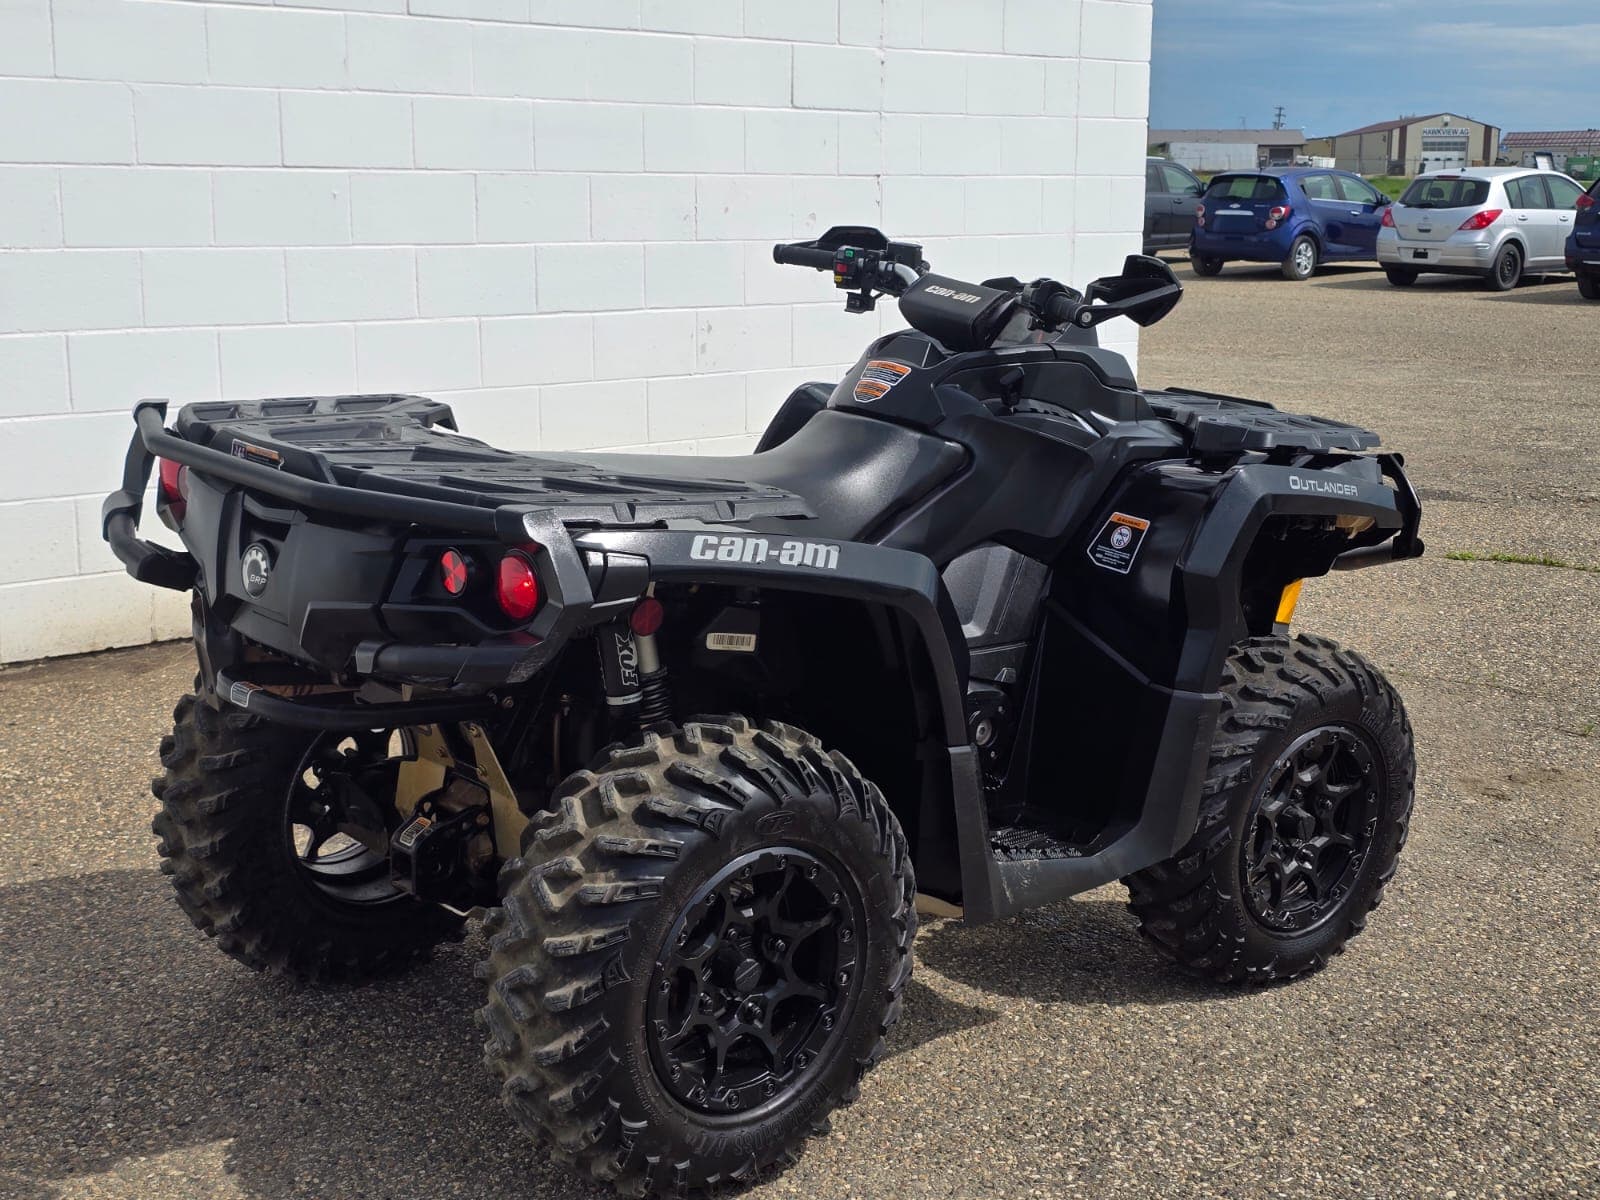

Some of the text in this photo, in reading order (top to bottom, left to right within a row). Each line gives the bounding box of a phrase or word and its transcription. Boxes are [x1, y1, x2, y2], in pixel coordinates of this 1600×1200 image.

[1422, 128, 1458, 136] HAWKVIEW
[924, 285, 981, 304] can-am
[690, 535, 841, 570] can-am
[249, 574, 267, 585] BRP
[615, 629, 639, 686] FOX
